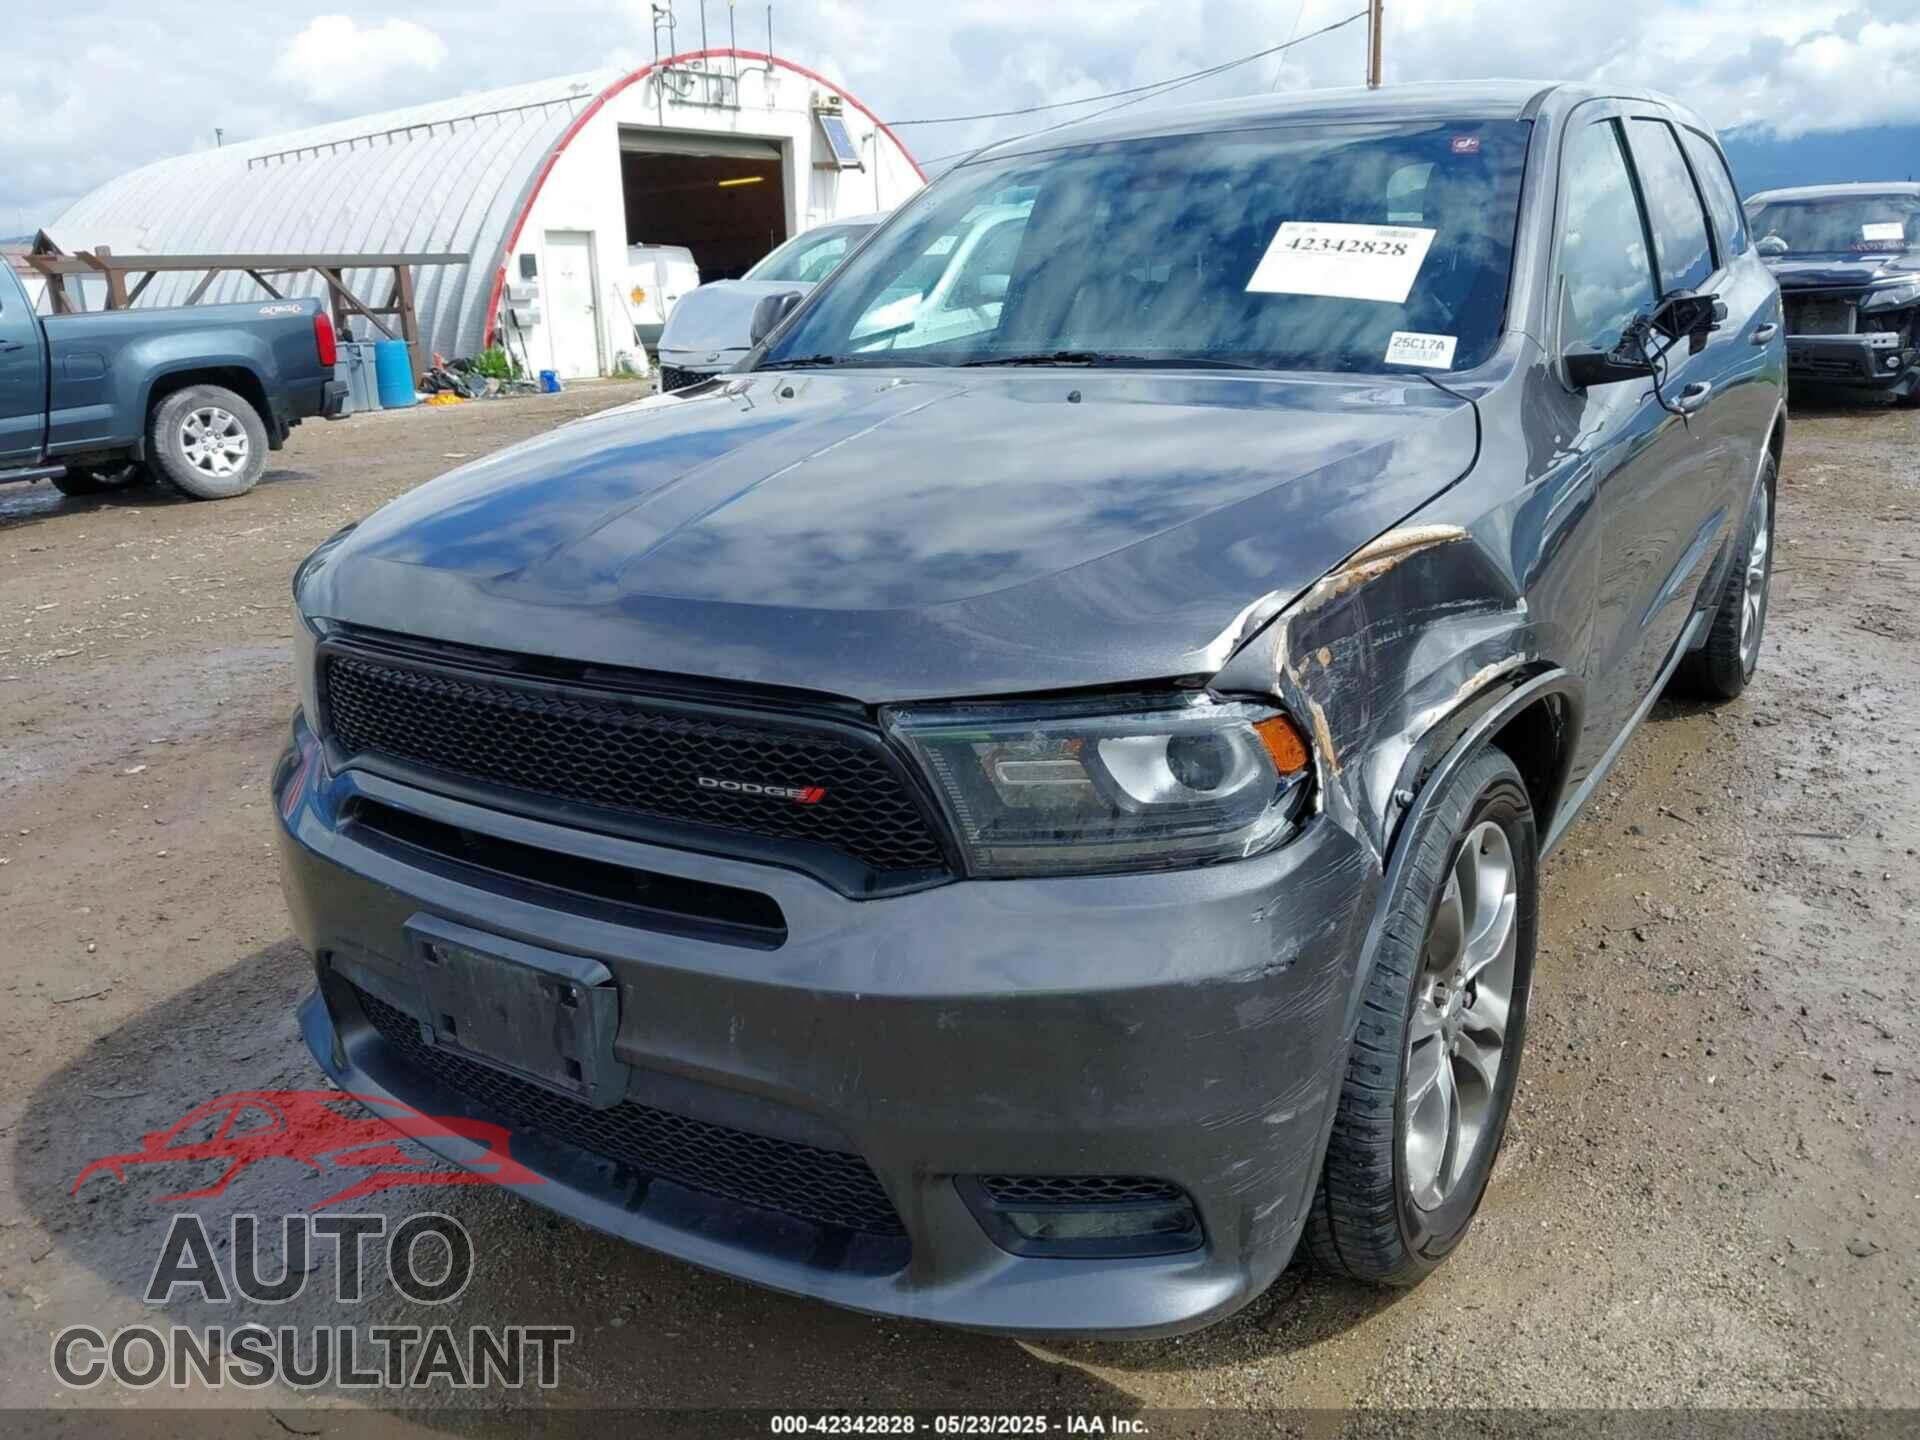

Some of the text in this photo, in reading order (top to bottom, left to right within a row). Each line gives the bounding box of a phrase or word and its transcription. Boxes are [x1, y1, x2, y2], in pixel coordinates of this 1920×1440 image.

[1285, 237, 1408, 256] 42342828
[1393, 336, 1445, 351] 25C17A
[698, 776, 809, 799] DODGE
